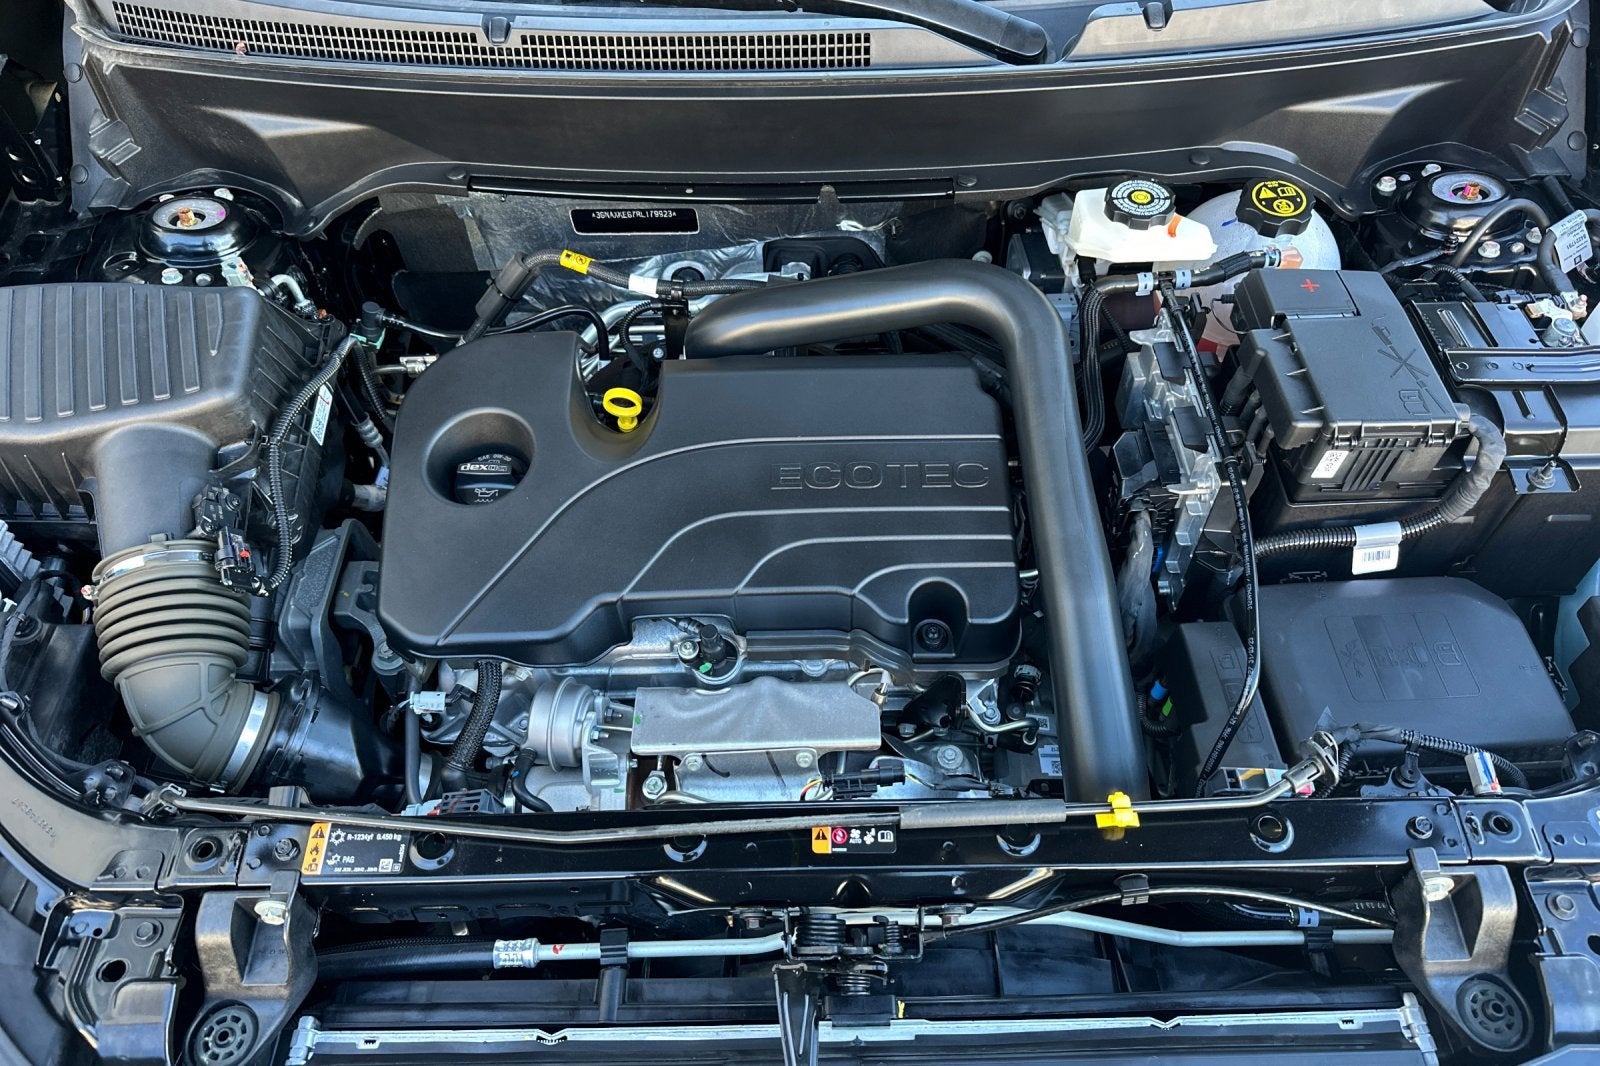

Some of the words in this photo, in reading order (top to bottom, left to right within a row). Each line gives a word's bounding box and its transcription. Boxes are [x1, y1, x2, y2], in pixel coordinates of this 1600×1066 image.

[771, 461, 990, 490] ECOTEC
[347, 833, 374, 842] R-1234yf
[376, 833, 393, 841] 0.450
[393, 833, 402, 842] kg
[342, 855, 355, 864] PAG
